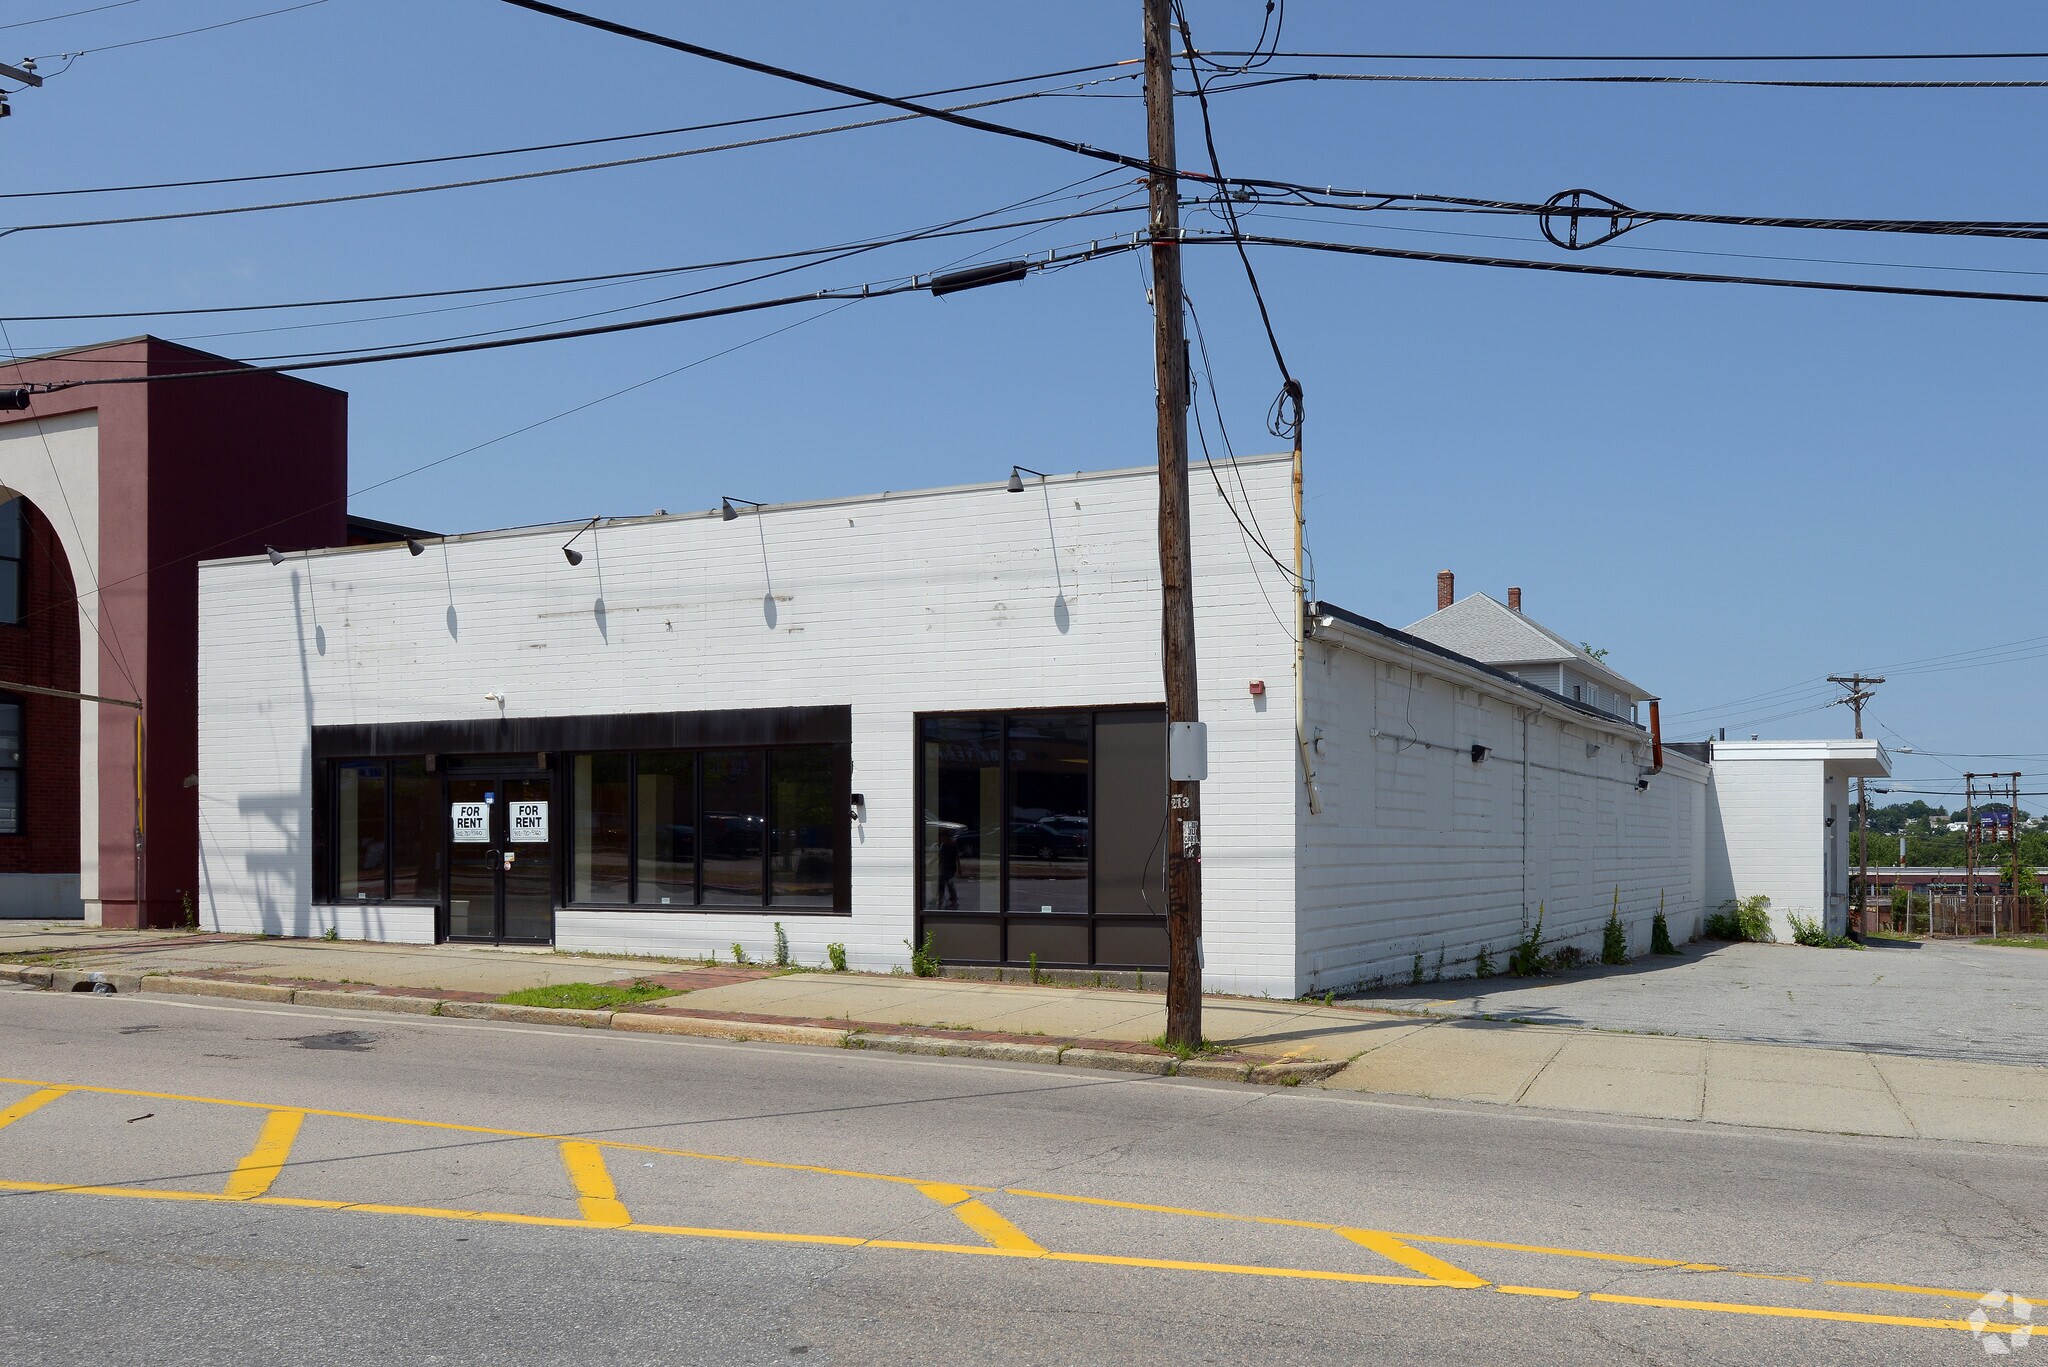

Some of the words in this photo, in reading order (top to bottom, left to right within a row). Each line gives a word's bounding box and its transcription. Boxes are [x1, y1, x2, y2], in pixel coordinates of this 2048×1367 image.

[460, 806, 480, 816] FOR
[519, 805, 539, 816] FOR
[457, 817, 483, 828] RENT
[515, 816, 542, 828] RENT
